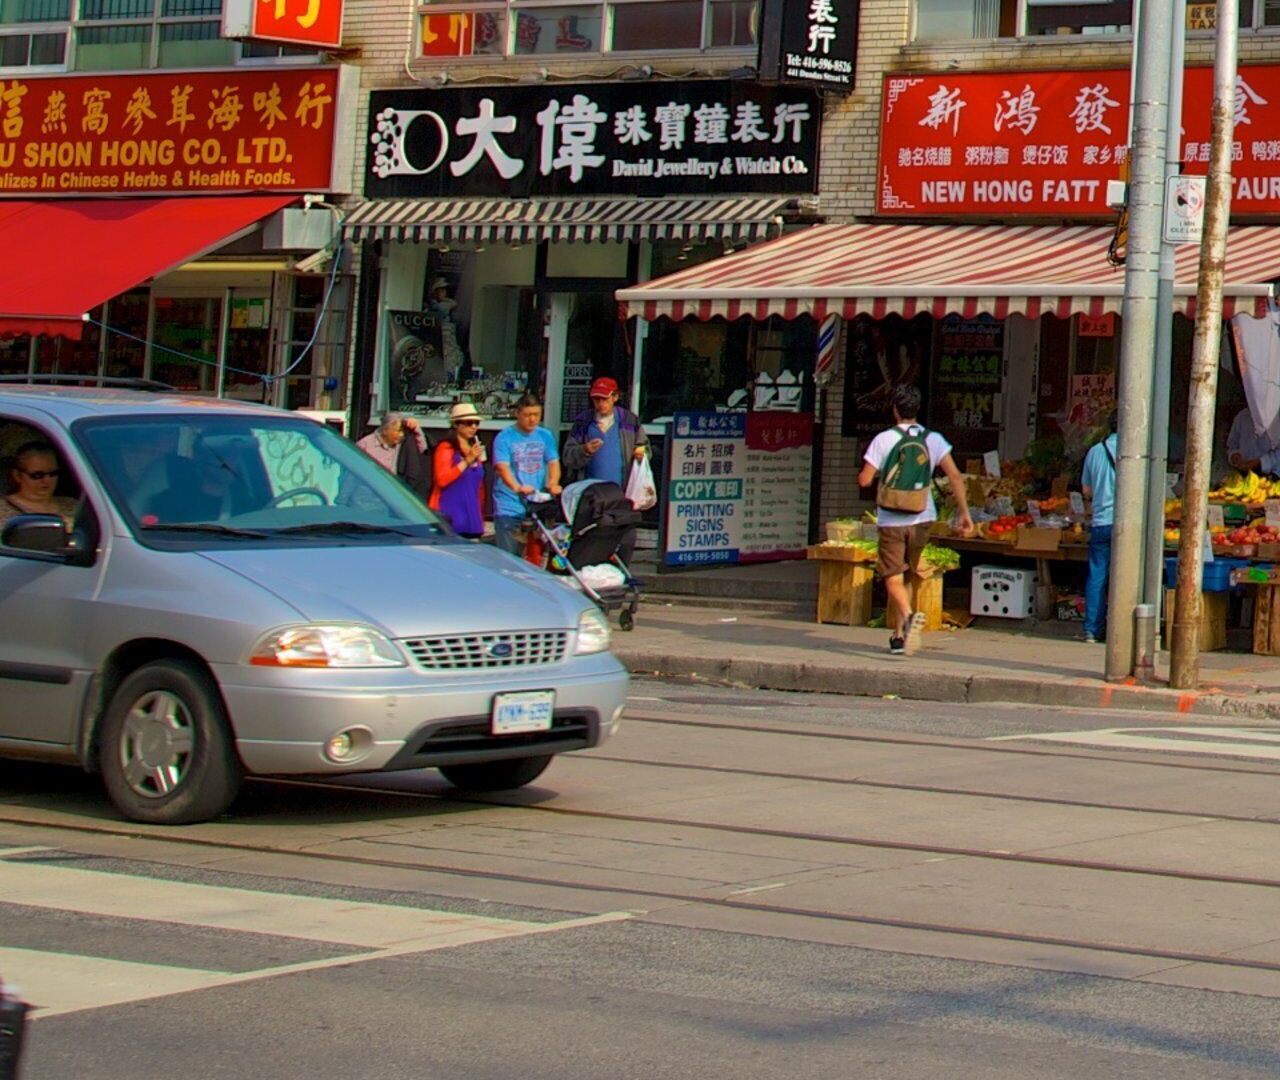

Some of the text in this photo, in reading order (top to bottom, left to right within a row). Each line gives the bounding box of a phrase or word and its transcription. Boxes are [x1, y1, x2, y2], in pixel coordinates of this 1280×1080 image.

[450, 94, 607, 182] 大偉
[24, 142, 92, 168] SHON
[101, 140, 175, 166] HONG
[183, 138, 227, 165] CO.
[237, 137, 293, 164] LTD.
[612, 156, 808, 179] David Jewellery & Watch Co.
[42, 171, 55, 187] In
[60, 171, 119, 187] Chinese
[124, 171, 167, 186] Herbs
[172, 171, 183, 186] &
[188, 169, 240, 185] Health
[244, 168, 295, 185] Foods.
[921, 181, 966, 203] NEW
[973, 180, 1033, 202] HONG
[1043, 180, 1099, 202] FATT
[394, 314, 436, 327] GUCCI
[566, 367, 590, 376] OPEN
[947, 393, 991, 411] TAX
[684, 445, 705, 458] 名片
[683, 462, 705, 475] 印刷
[675, 482, 713, 499] COPY
[677, 504, 734, 517] PRINTING
[686, 519, 724, 532] SIGNS
[679, 533, 729, 548] STAMPS
[678, 552, 729, 561] 416-595-5050
